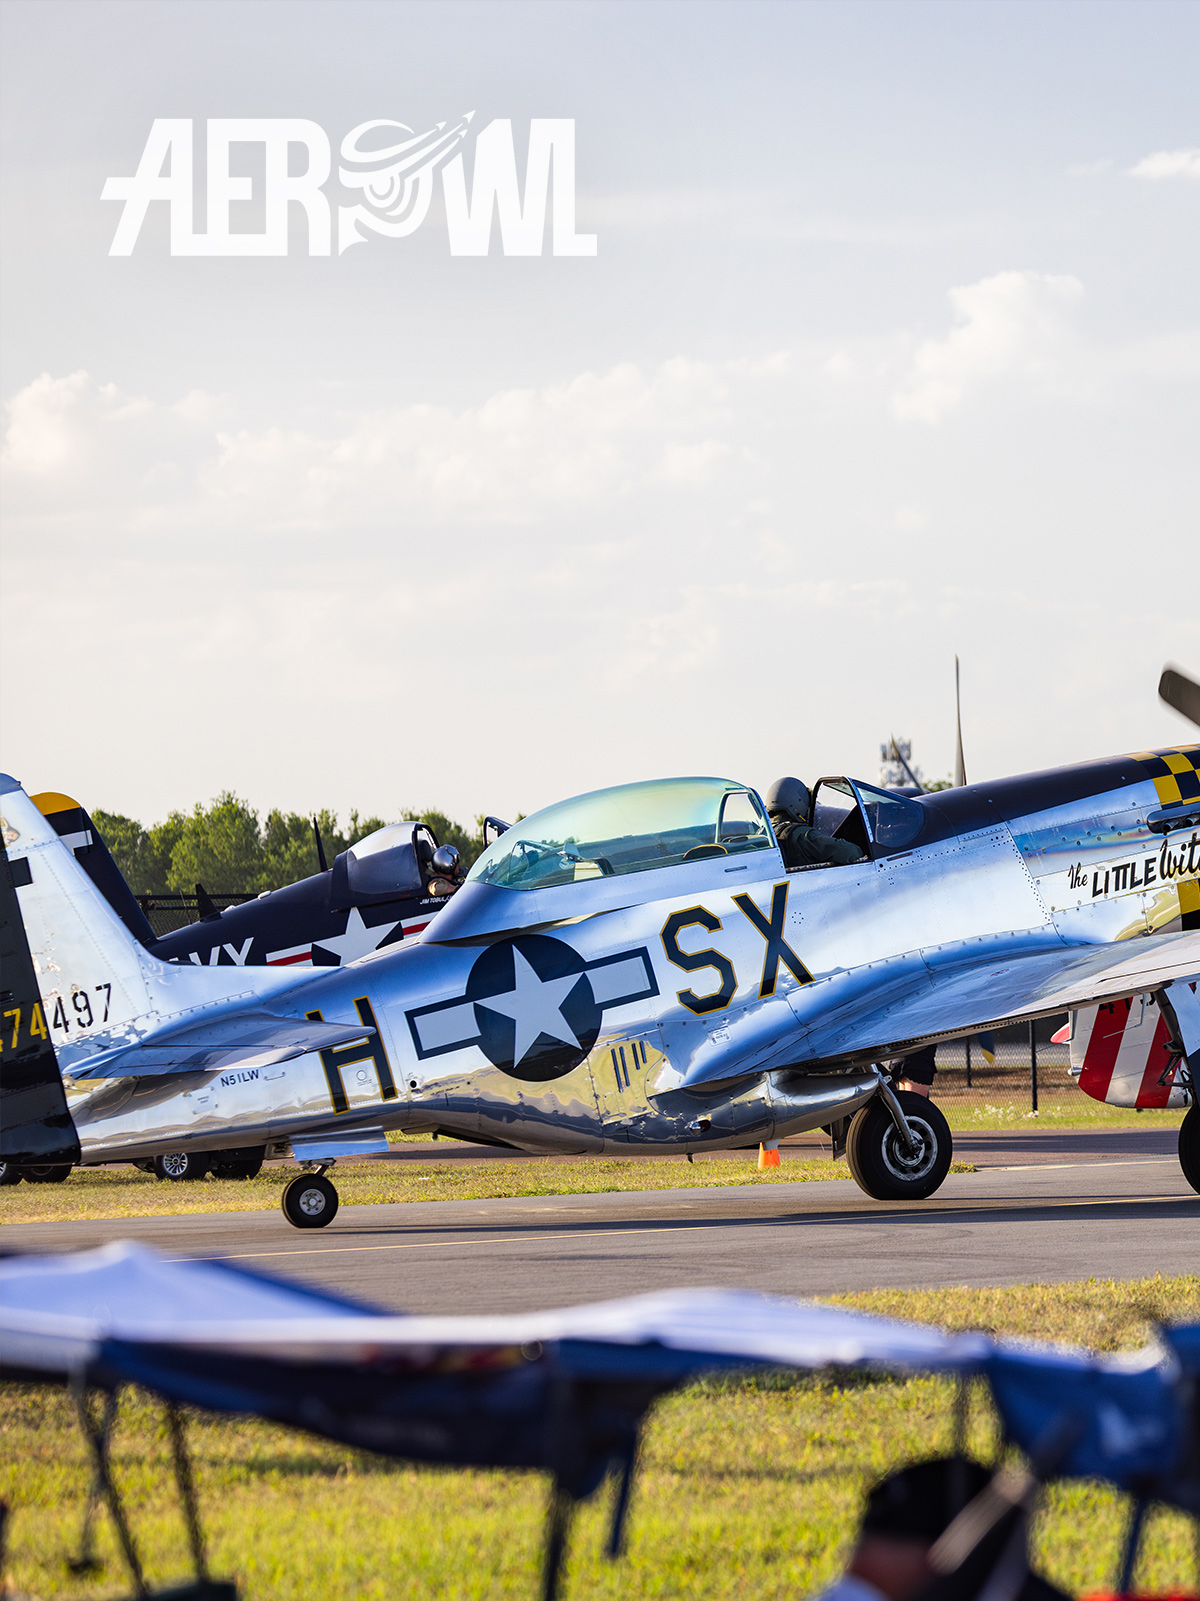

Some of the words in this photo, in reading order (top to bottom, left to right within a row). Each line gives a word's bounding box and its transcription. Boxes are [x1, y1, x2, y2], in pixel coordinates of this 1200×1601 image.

[1092, 857, 1157, 898] LITTLE
[659, 880, 816, 1016] SX
[0, 983, 112, 1053] 74497
[304, 995, 398, 1116] H
